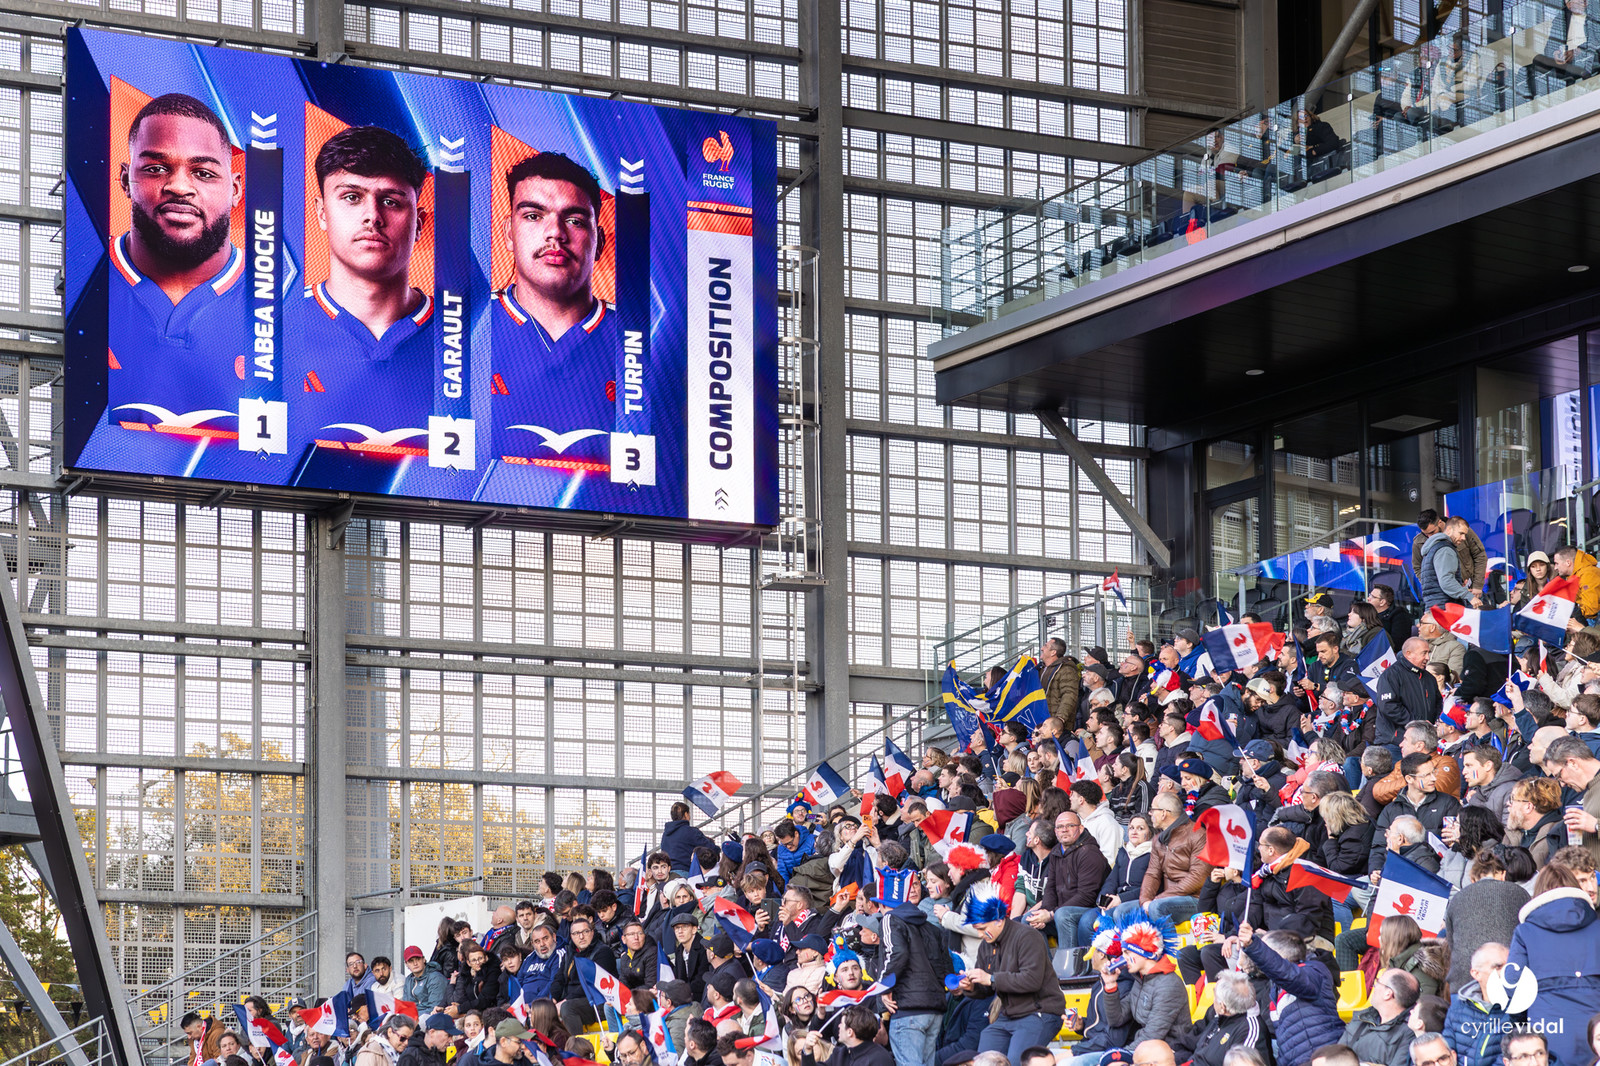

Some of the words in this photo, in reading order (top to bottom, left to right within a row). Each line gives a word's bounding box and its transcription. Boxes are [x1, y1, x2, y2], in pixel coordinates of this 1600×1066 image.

[702, 173, 735, 183] FRANCE
[702, 180, 735, 190] RUGBY
[254, 209, 275, 300] NJOCKE
[254, 305, 275, 382] JABEA
[443, 290, 462, 399] GARAULT
[708, 257, 733, 470] COMPOSITION
[624, 330, 643, 415] TURPIN
[256, 414, 271, 440] 1
[444, 432, 461, 456] 2
[625, 448, 641, 471] 3
